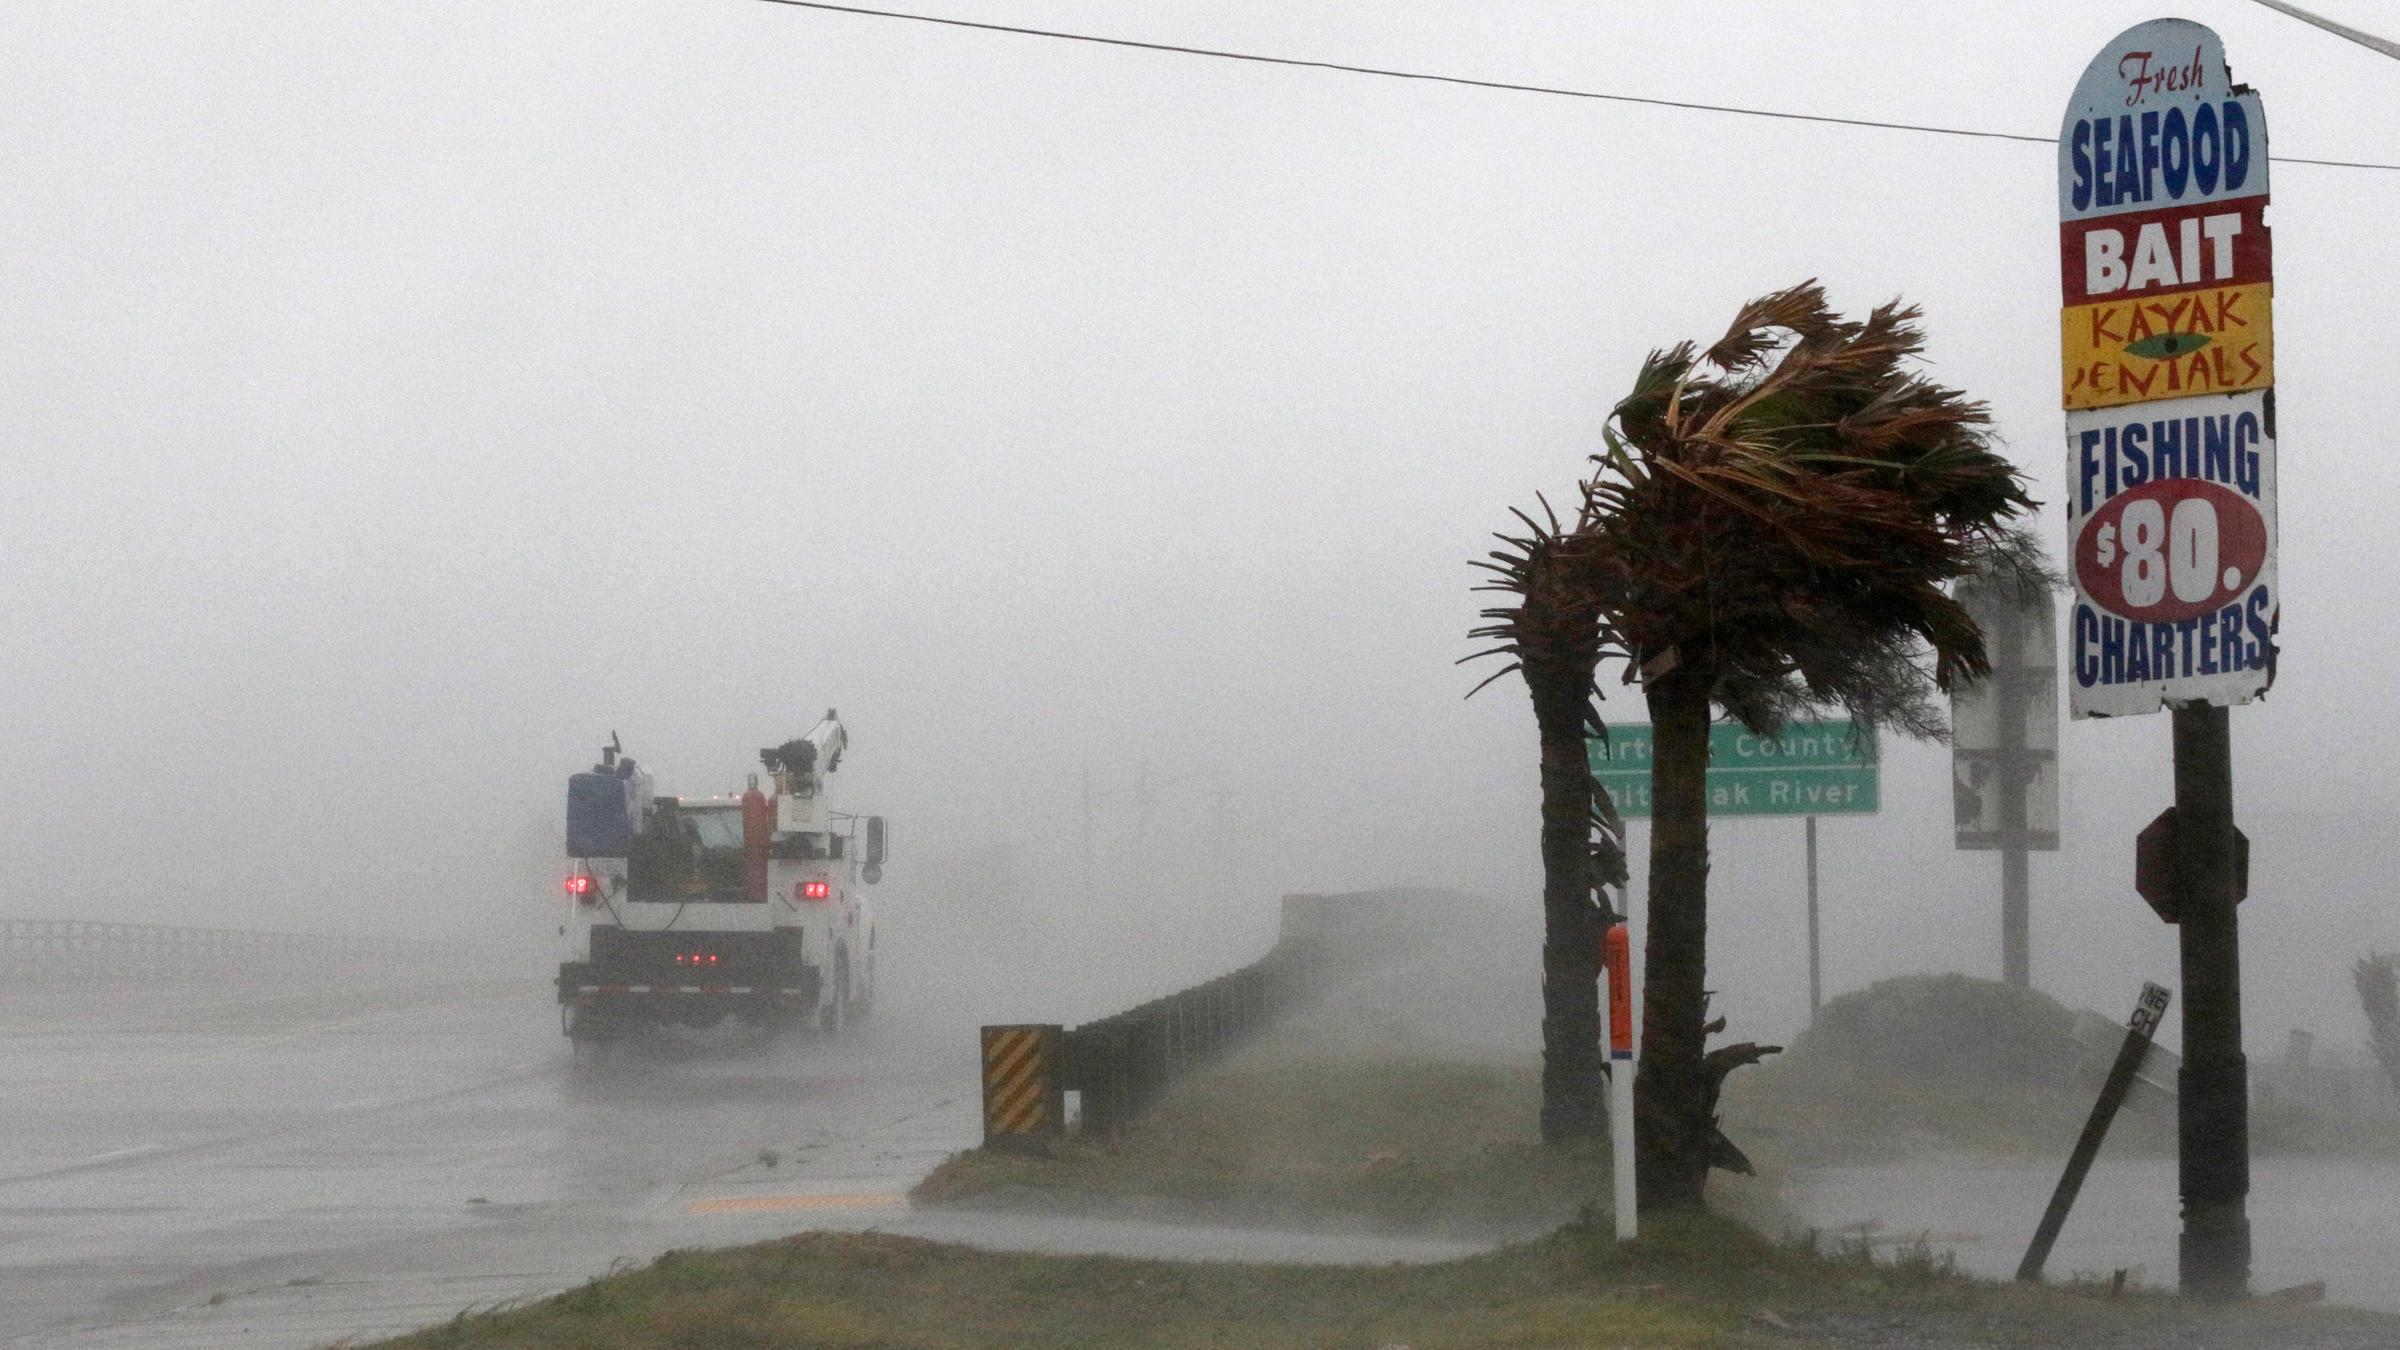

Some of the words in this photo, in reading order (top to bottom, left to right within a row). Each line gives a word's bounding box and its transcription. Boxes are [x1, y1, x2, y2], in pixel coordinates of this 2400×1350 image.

[2118, 45, 2204, 107] Fresh
[2072, 101, 2250, 212] SEAFOOD
[2085, 212, 2242, 295] BAIT
[2091, 291, 2248, 349] KAYAK
[2063, 342, 2262, 405] ENTALS
[2081, 411, 2260, 517] FISHING
[2075, 584, 2270, 688] CHARTERS
[1736, 732, 1857, 761] County
[1711, 783, 1749, 806] ak
[1770, 780, 1858, 804] River
